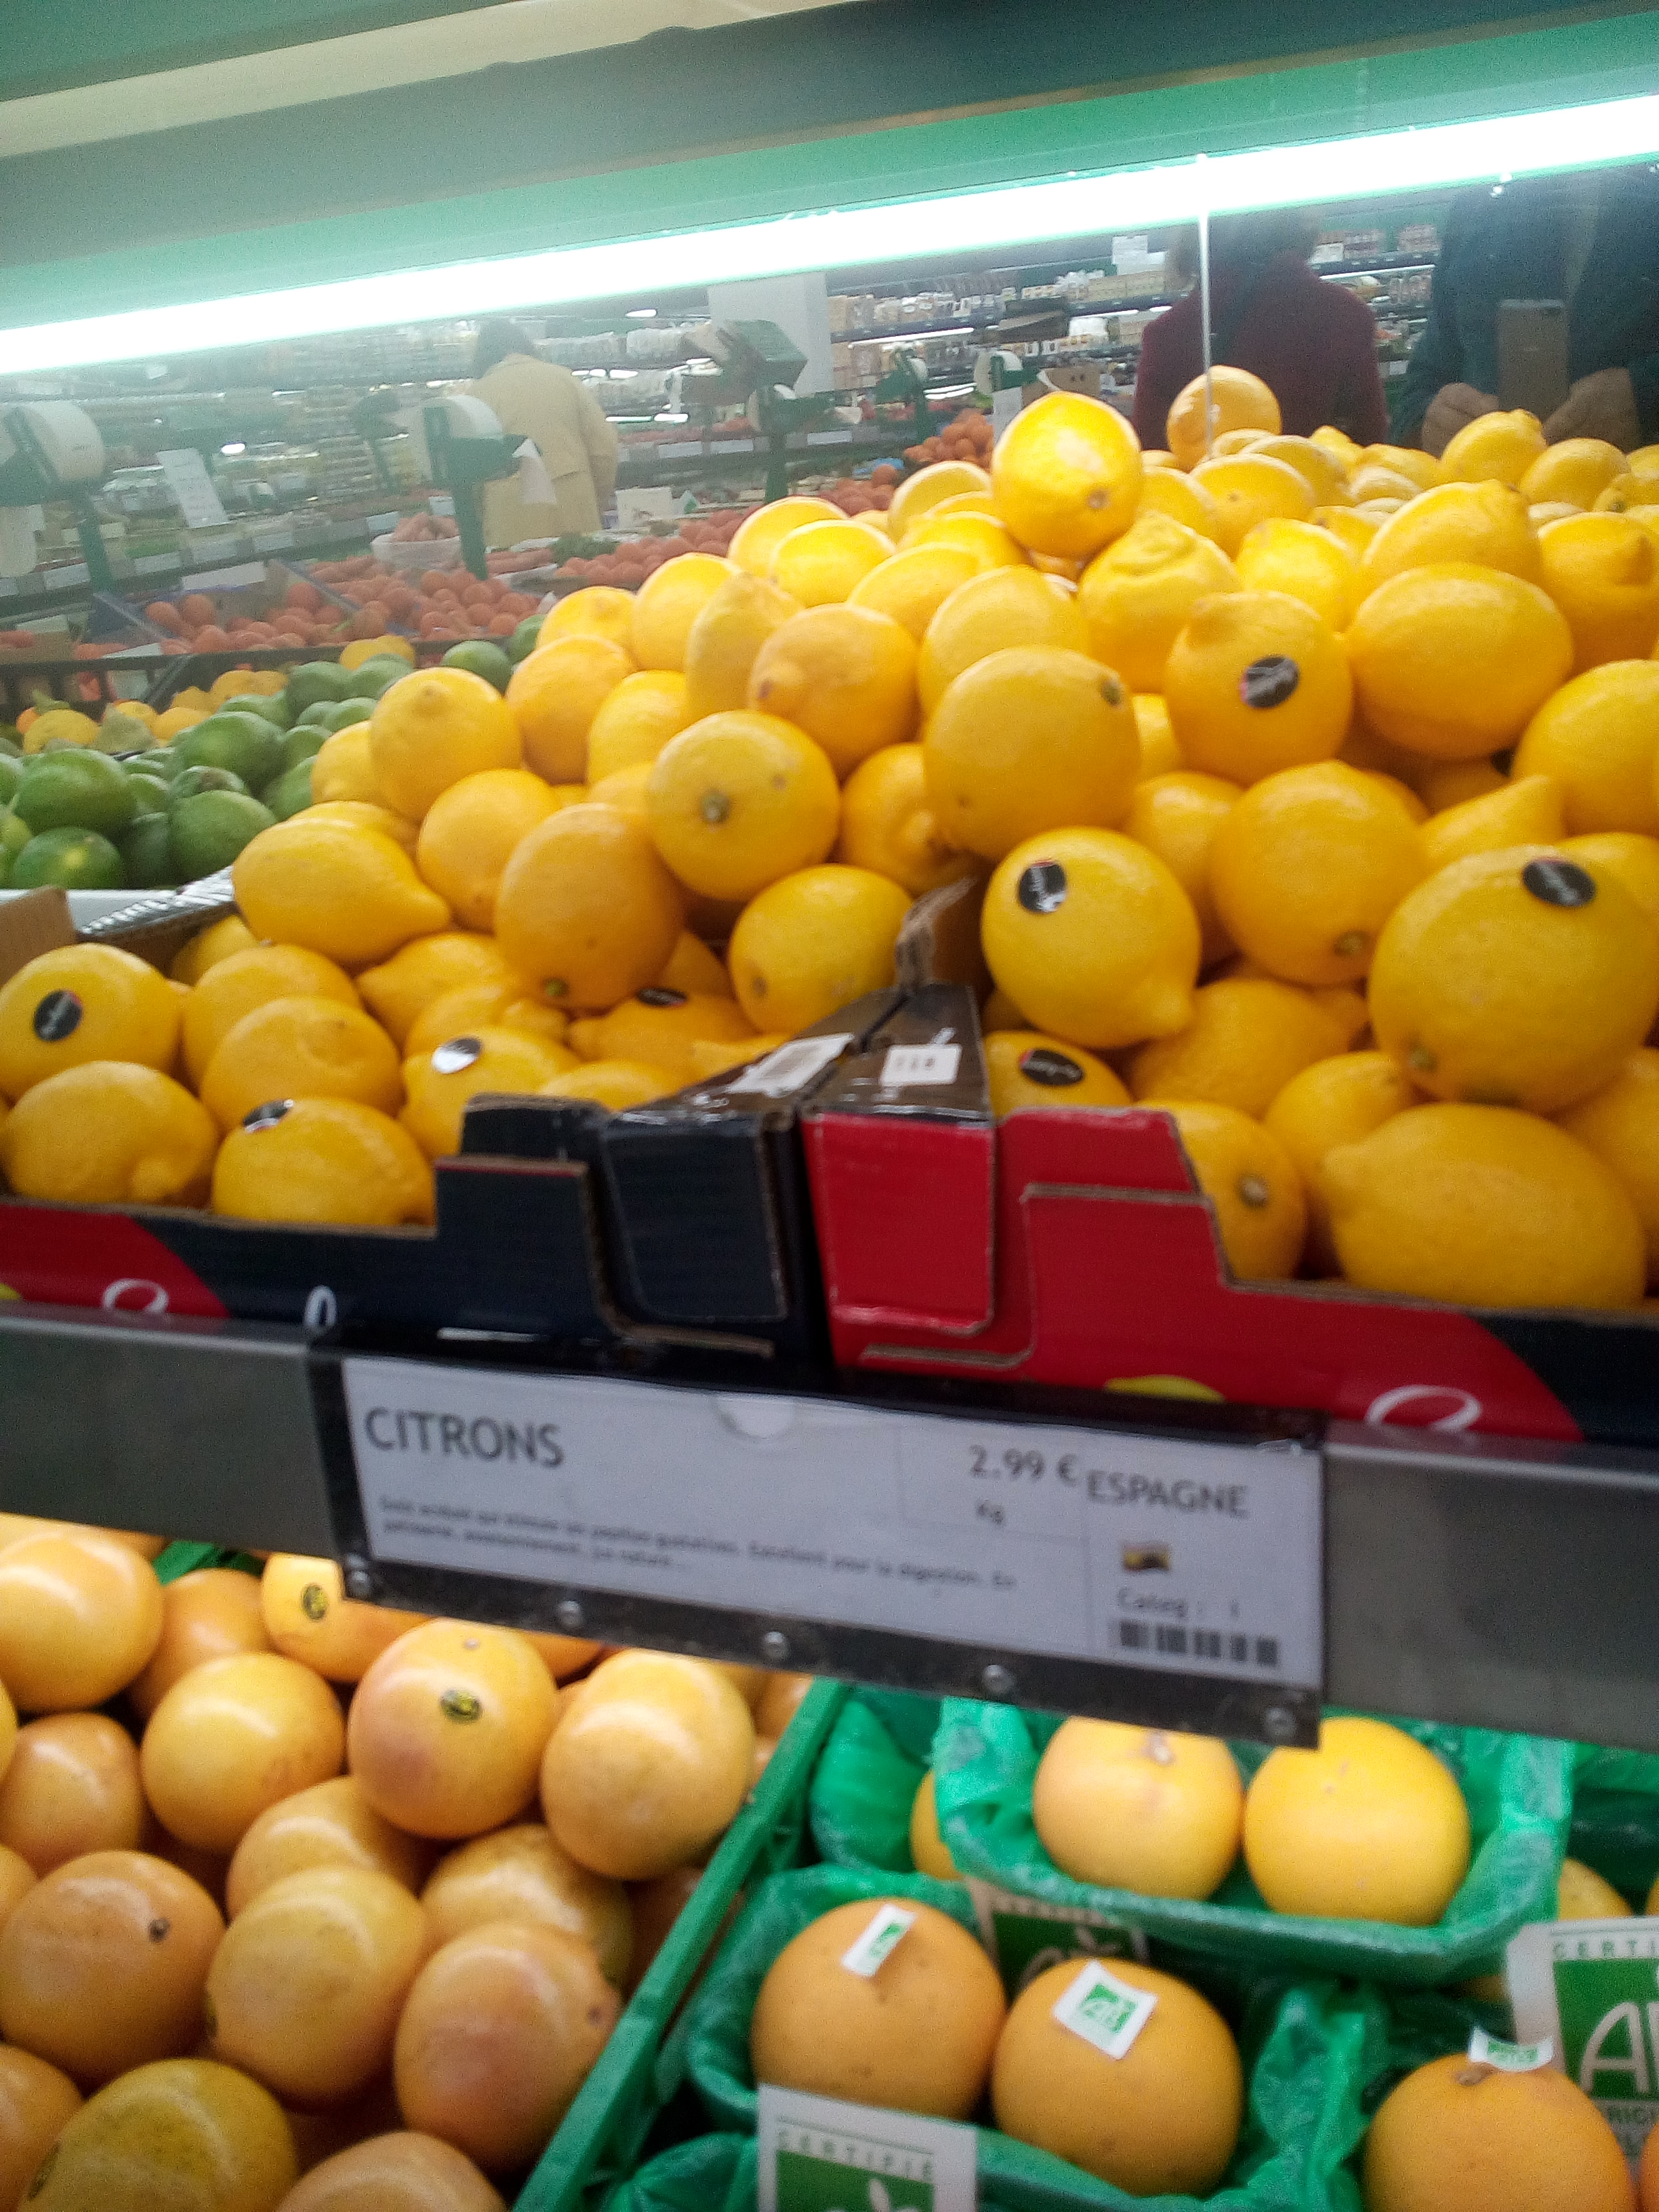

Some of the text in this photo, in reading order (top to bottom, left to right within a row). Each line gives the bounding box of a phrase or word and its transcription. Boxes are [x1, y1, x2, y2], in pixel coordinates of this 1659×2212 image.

[364, 1405, 564, 1467] CITRONS
[970, 1444, 1079, 1487] 2.99 €
[1087, 1469, 1248, 1517] ESPAGNE
